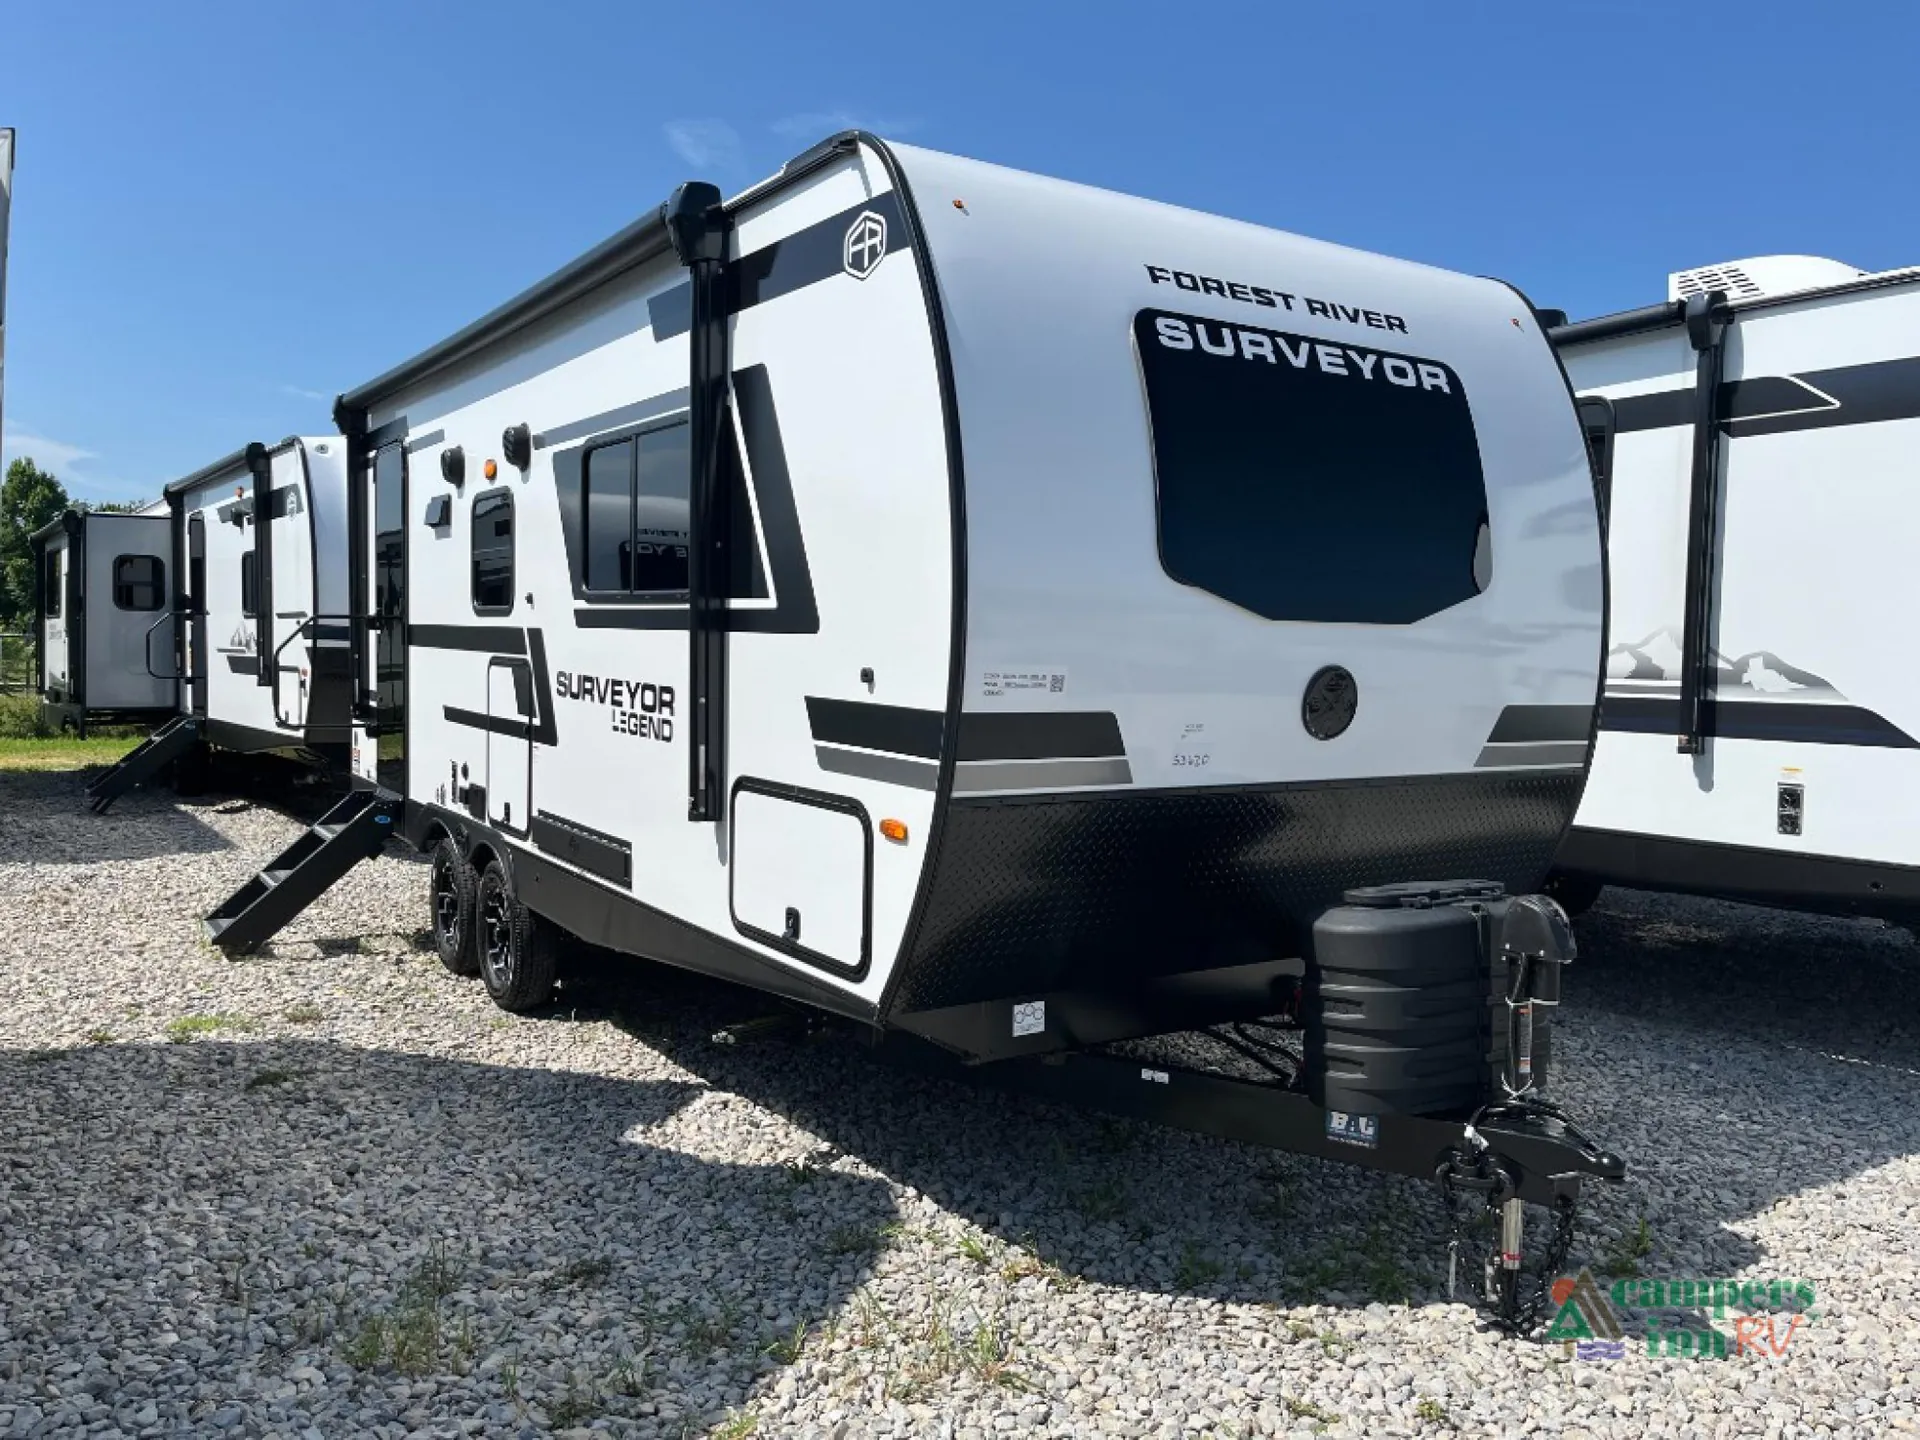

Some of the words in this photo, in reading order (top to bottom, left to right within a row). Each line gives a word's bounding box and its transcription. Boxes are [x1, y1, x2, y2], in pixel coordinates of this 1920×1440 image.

[1145, 263, 1296, 311] FOREST
[1303, 297, 1409, 334] RIVER
[1154, 316, 1452, 394] SURVEYOR
[556, 671, 676, 717] SURVEYOR
[611, 709, 674, 743] LEGEND
